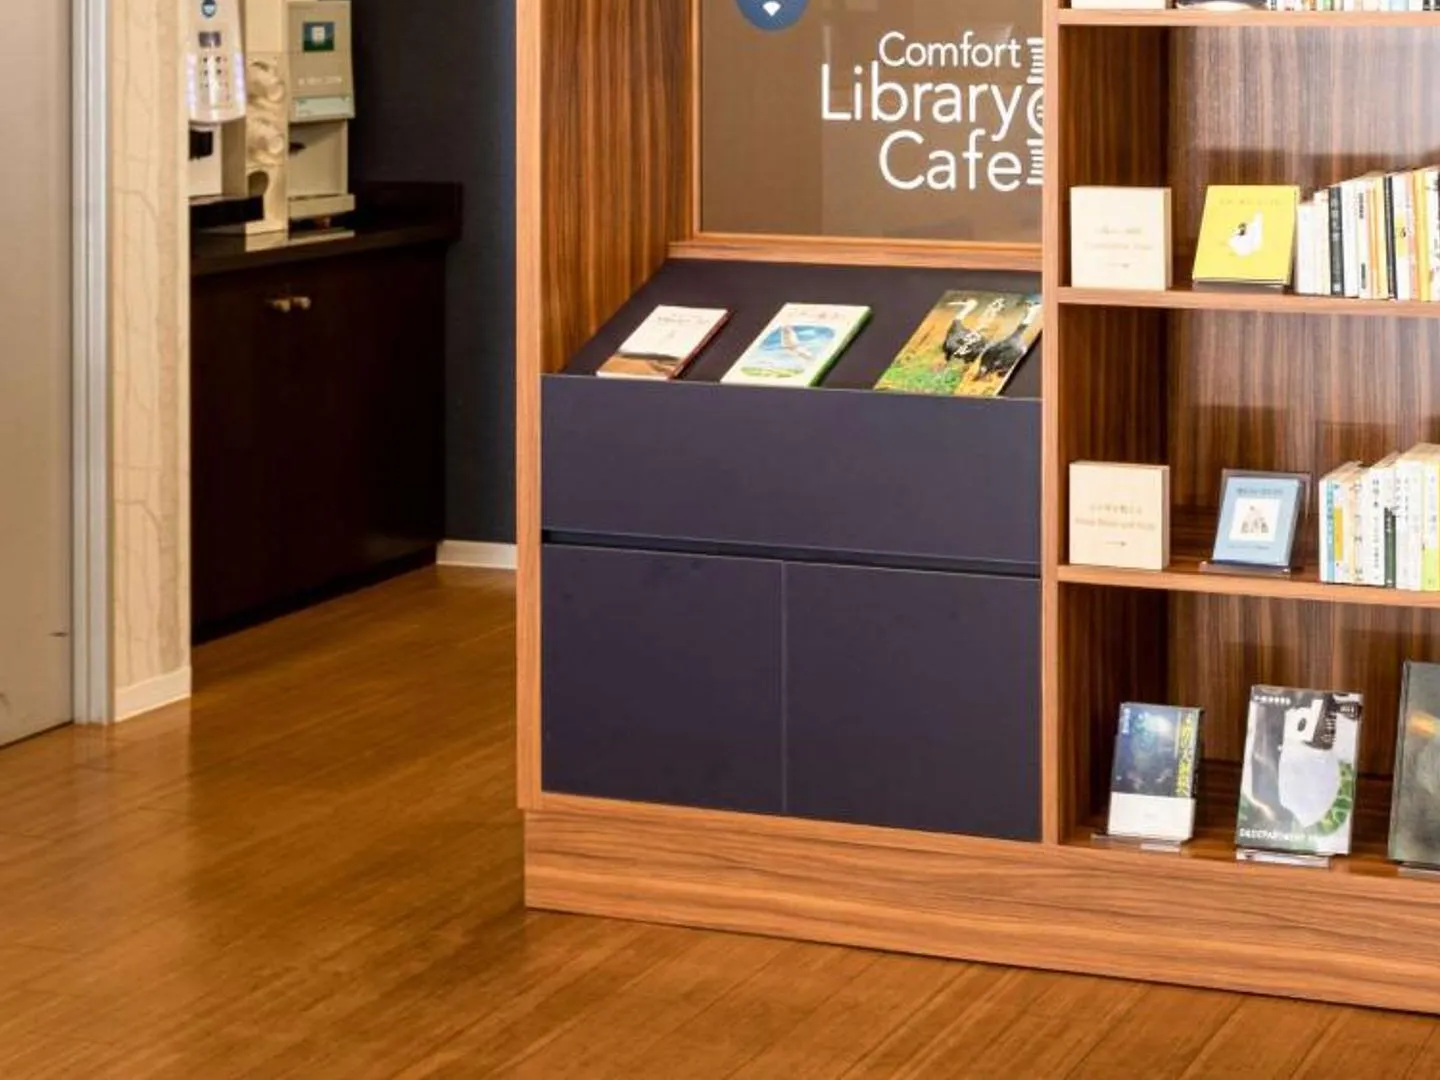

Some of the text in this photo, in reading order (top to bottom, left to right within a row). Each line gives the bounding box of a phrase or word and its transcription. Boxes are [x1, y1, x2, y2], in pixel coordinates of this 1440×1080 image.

[878, 30, 1022, 68] Comfort
[821, 60, 1023, 142] Library
[879, 128, 1022, 192] Cafe
